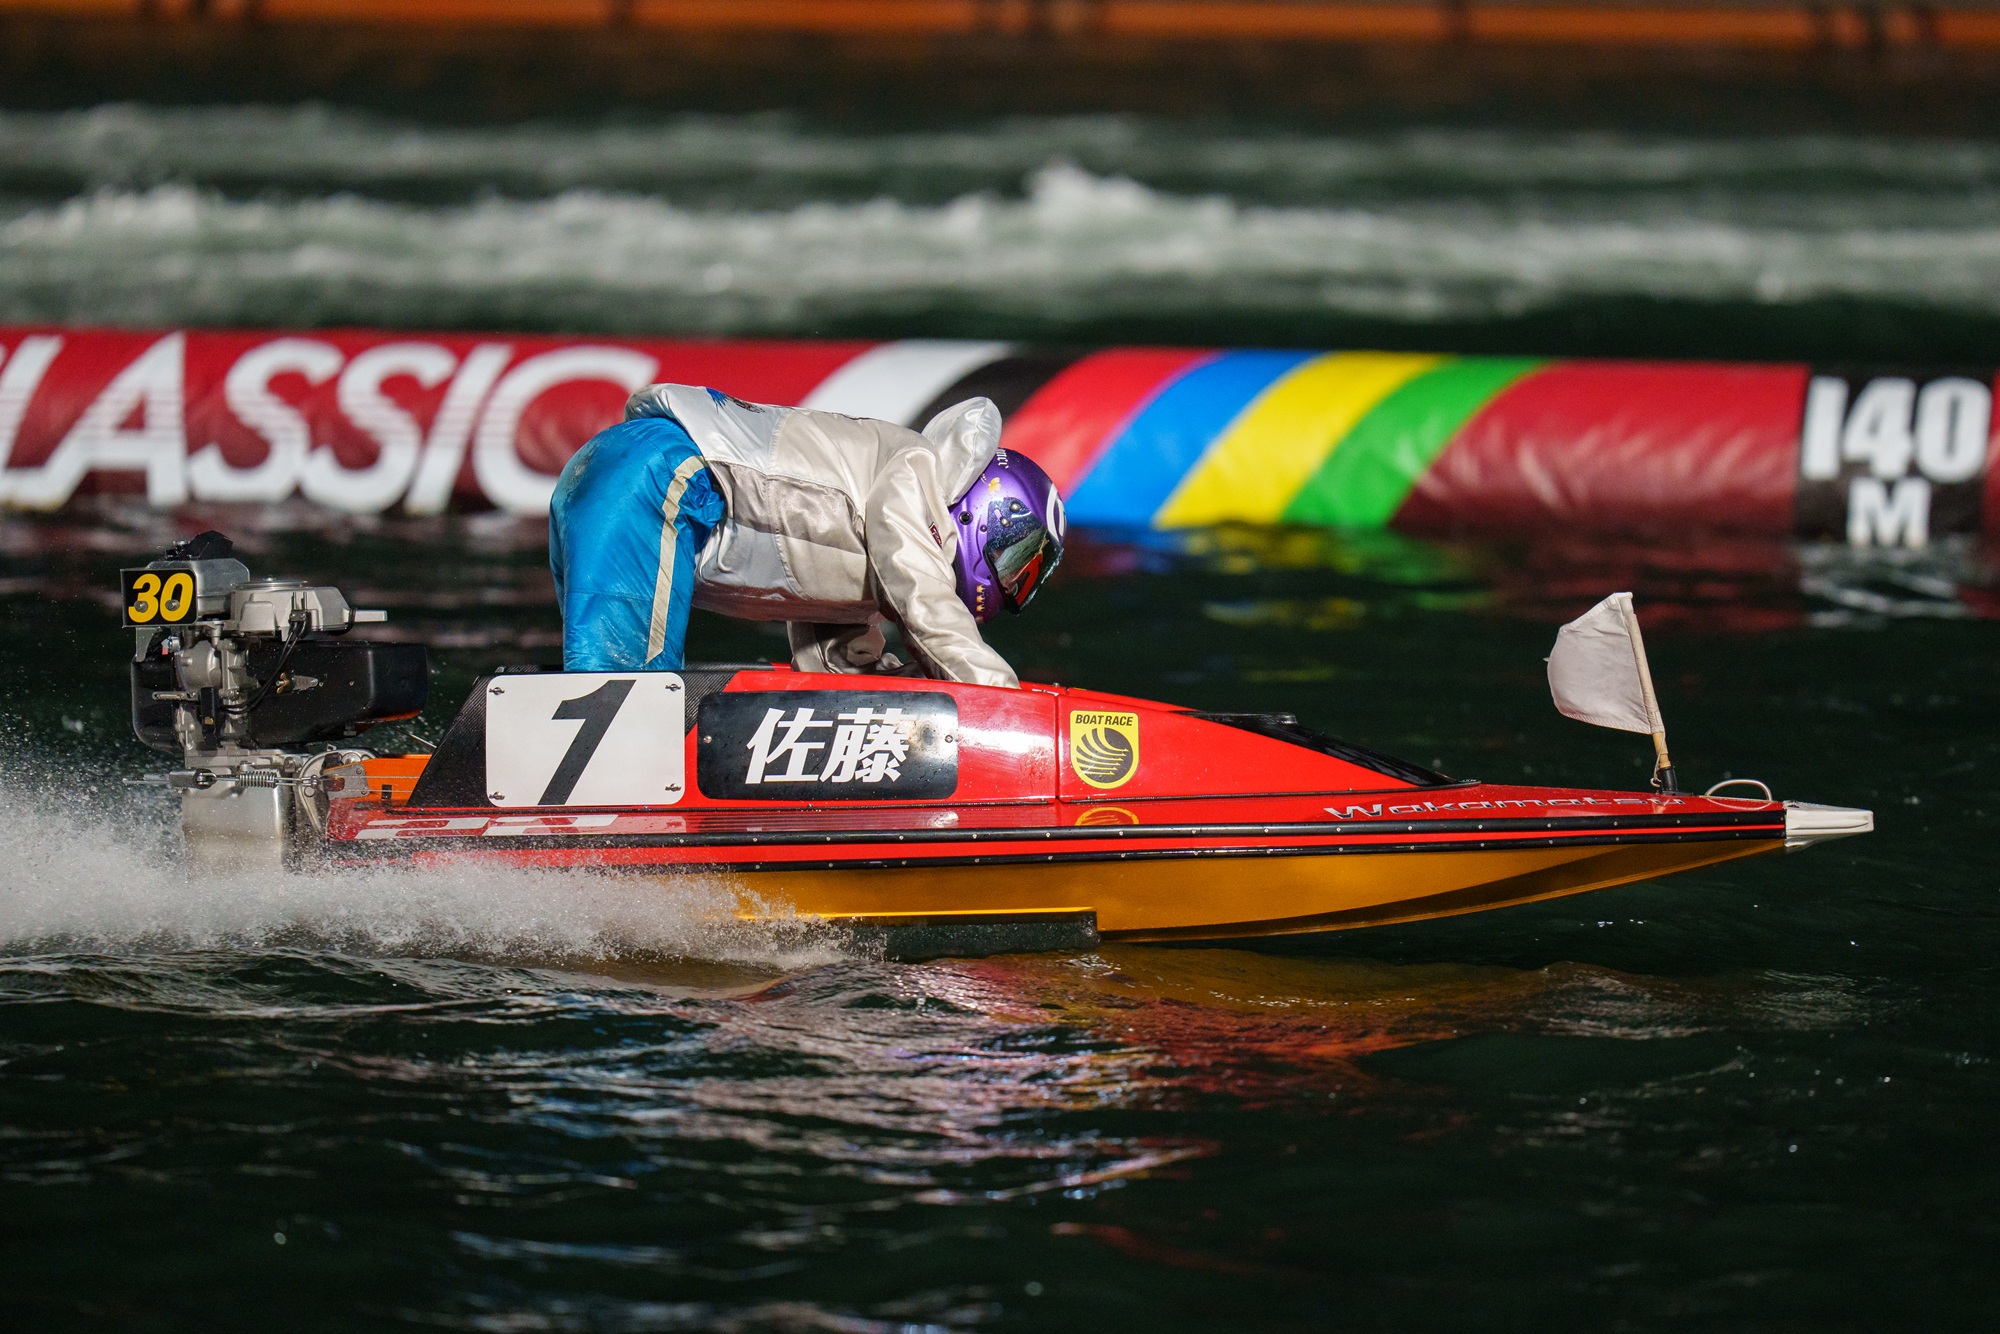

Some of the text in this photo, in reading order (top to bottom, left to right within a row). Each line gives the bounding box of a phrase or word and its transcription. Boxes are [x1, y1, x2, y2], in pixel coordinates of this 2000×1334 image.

[0, 331, 661, 514] LASSIC
[1801, 375, 1992, 483] 140
[1847, 476, 1932, 549] M
[128, 572, 194, 623] 30
[537, 679, 637, 806] 1
[744, 706, 918, 785] 佐藤
[1075, 713, 1134, 727] BOAT RACE
